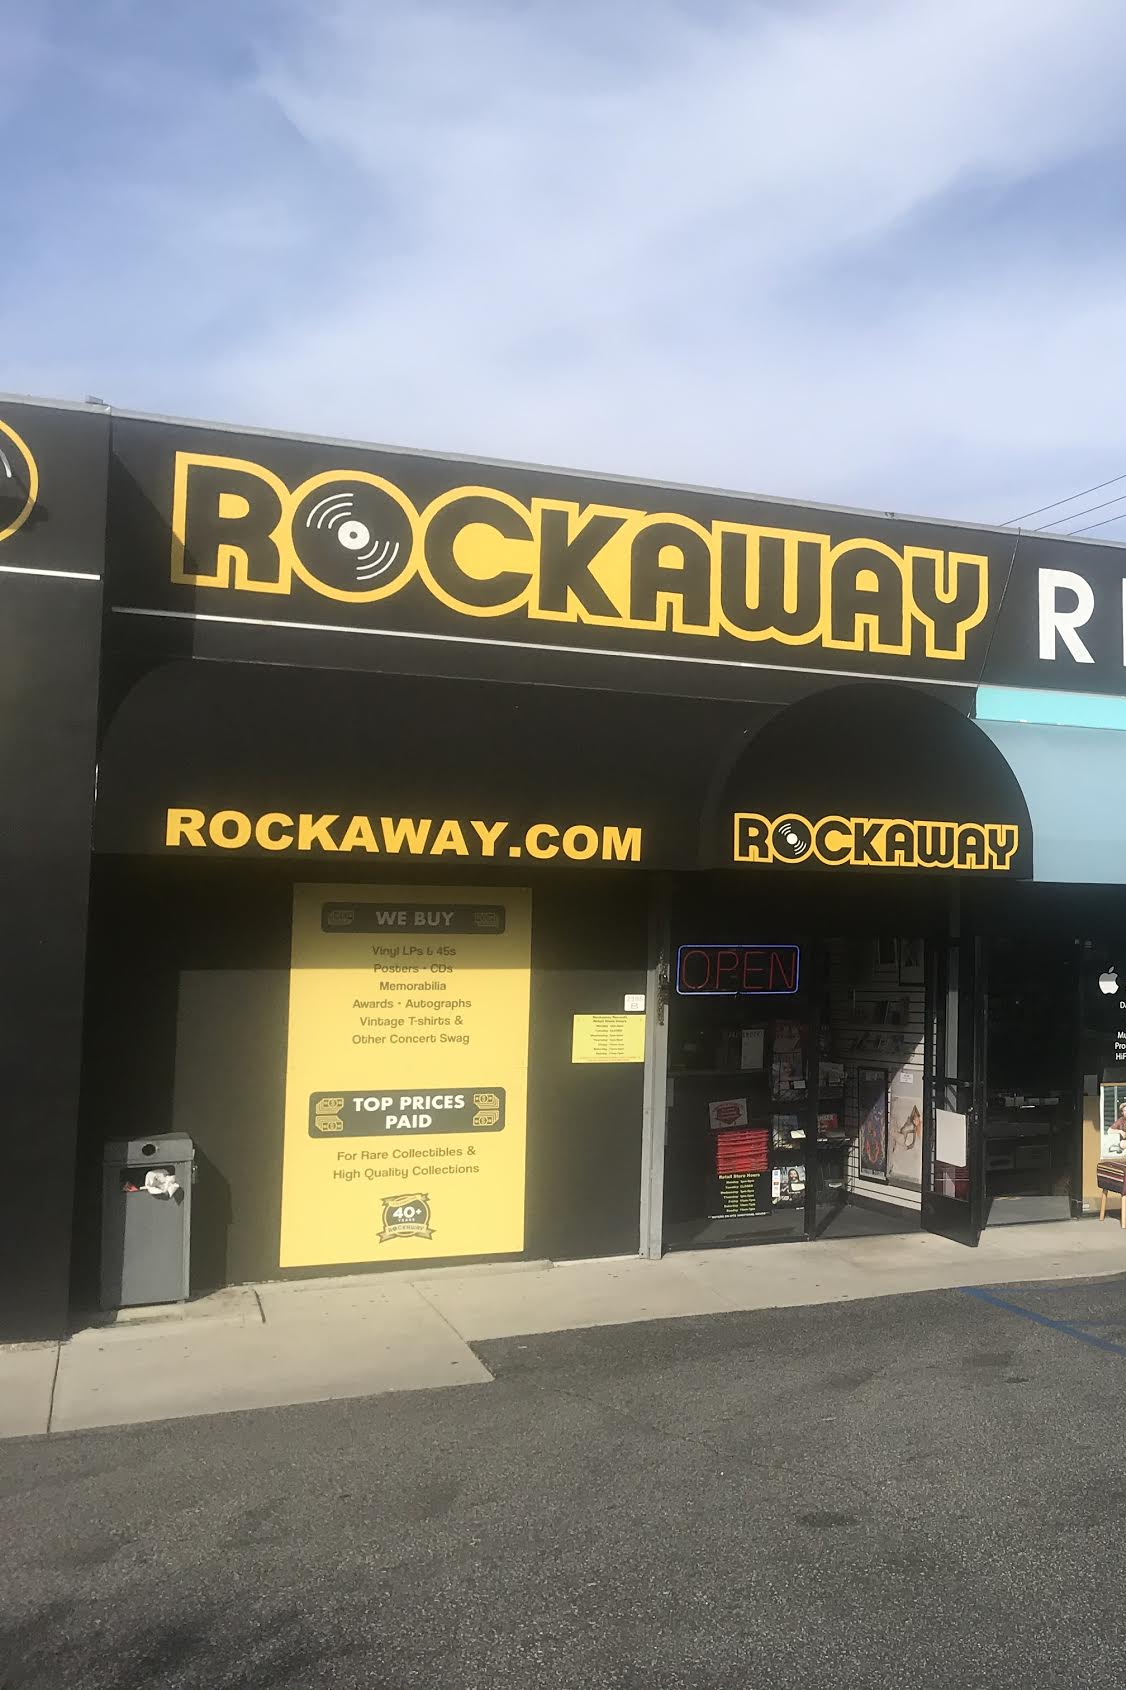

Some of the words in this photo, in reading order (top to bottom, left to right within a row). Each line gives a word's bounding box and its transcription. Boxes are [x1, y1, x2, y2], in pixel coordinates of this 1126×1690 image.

[171, 450, 990, 662] ROCKAWAY
[165, 807, 643, 863] ROCKAWAY.COM
[734, 813, 1020, 871] ROCKAWAY
[375, 911, 407, 926] WE
[414, 911, 454, 926] BUY
[372, 946, 400, 958] Vinyl
[402, 946, 423, 956] LPs
[436, 946, 457, 956] 45s
[374, 963, 420, 973] Posters
[430, 964, 453, 973] CDs
[682, 950, 795, 990] OPEN
[379, 981, 447, 991] Memorabilia
[352, 999, 394, 1009] Awards
[405, 999, 472, 1011] Autographs
[359, 1016, 405, 1028] Vintage
[408, 1016, 451, 1026] T-shirts
[454, 1015, 463, 1026] &
[352, 1034, 386, 1045] Other
[389, 1034, 437, 1044] Concert
[439, 1033, 470, 1045] Swag
[1114, 1042, 1126, 1050] Pro
[352, 1097, 394, 1112] TOP
[400, 1095, 465, 1111] PRICES
[385, 1114, 433, 1129] PAID
[337, 1151, 357, 1161] For
[361, 1150, 389, 1160] Rare
[392, 1147, 463, 1159] Collectibles
[467, 1145, 476, 1156] &
[333, 1169, 360, 1181] High
[364, 1167, 409, 1181] Quality
[412, 1164, 480, 1176] Collections
[392, 1206, 422, 1219] 40+
